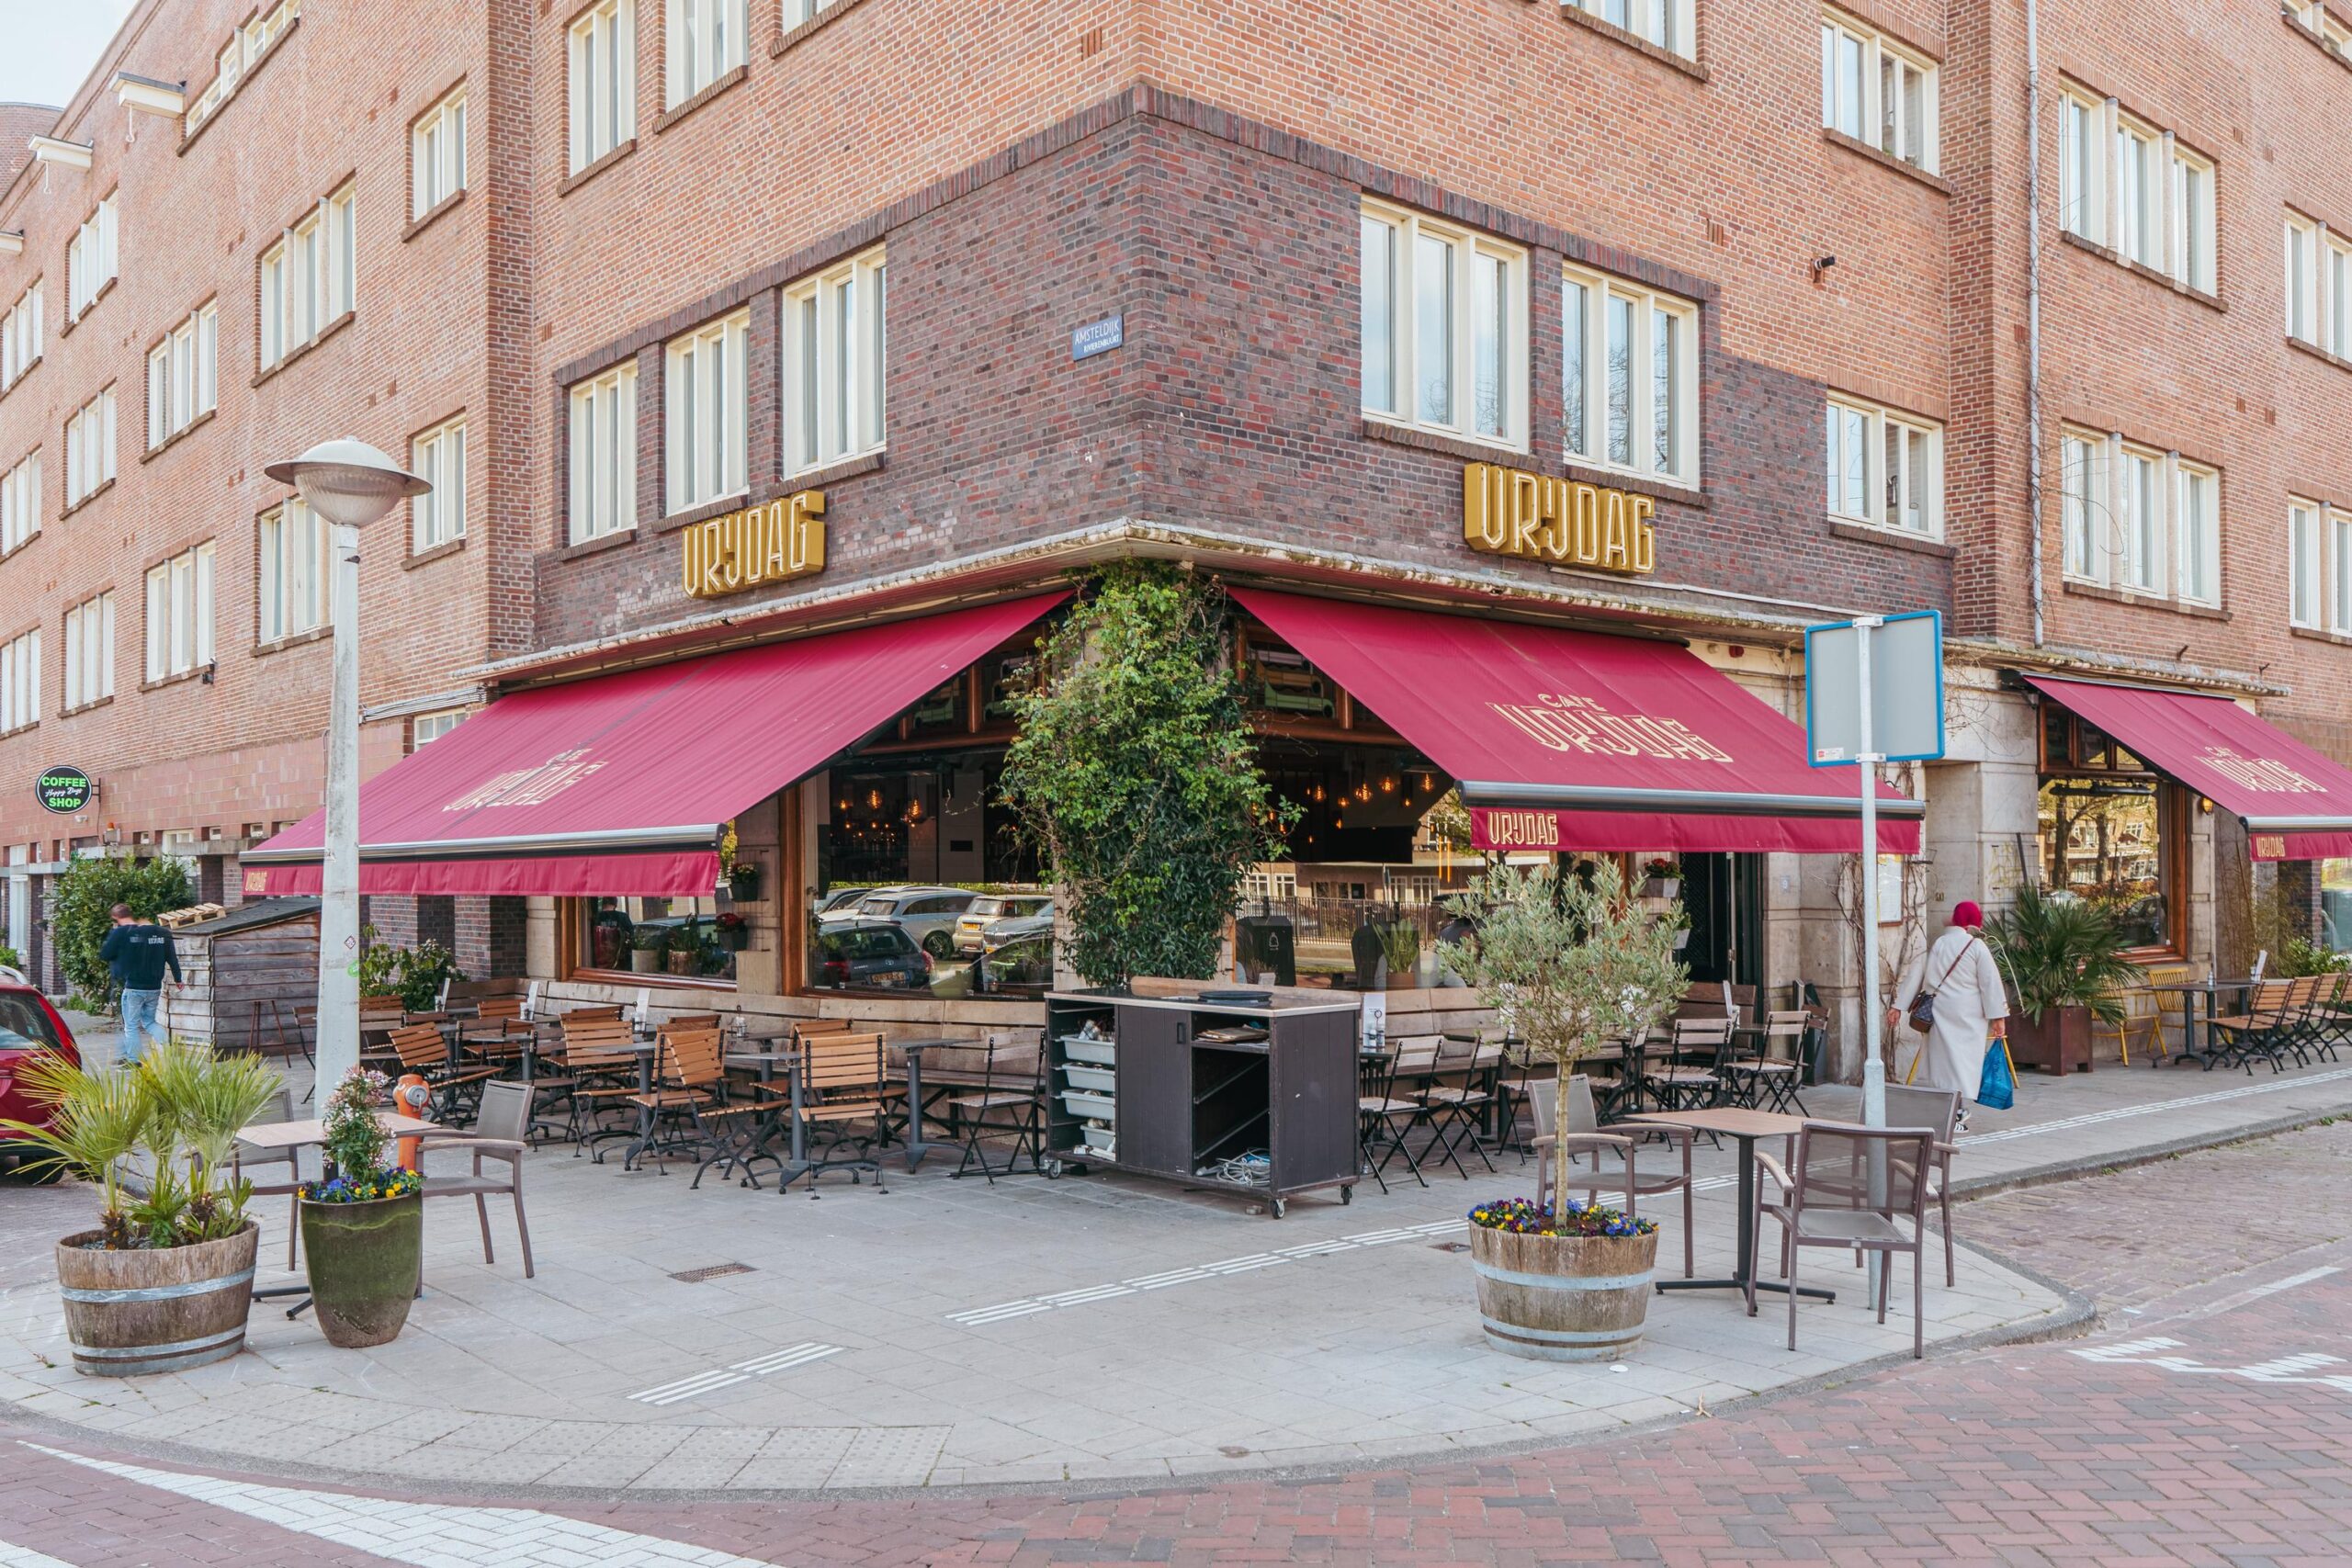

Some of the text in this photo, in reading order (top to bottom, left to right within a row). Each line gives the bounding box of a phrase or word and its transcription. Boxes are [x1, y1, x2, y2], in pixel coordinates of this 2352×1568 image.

[1075, 318, 1119, 344] AMSTELDIJK
[41, 776, 86, 788] COFFEE
[49, 797, 81, 807] SHOP
